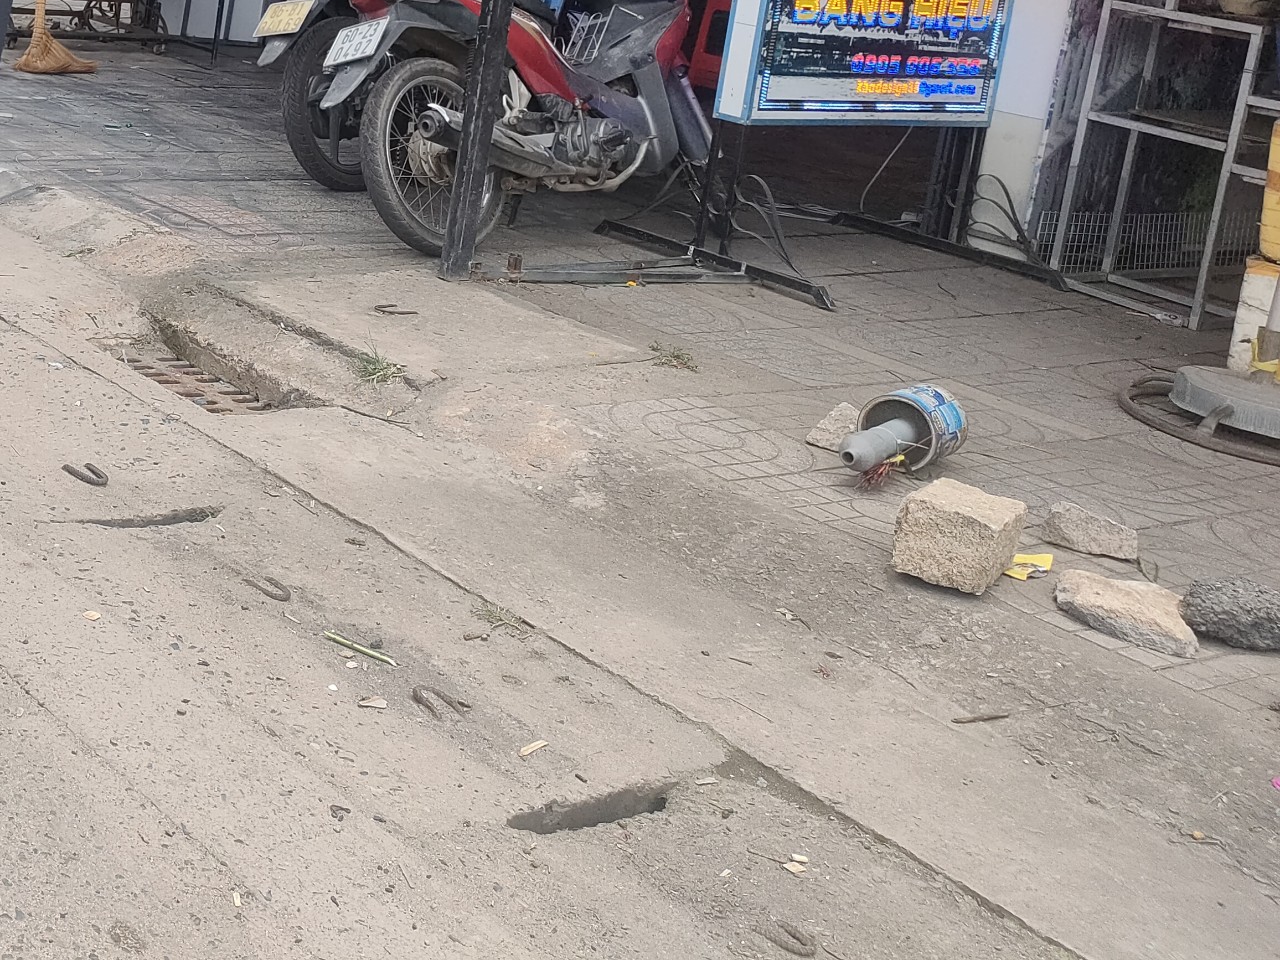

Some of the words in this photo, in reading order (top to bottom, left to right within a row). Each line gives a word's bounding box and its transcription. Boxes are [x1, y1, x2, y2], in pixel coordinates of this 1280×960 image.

[342, 22, 380, 45] 60-Z3
[334, 39, 373, 61] 0492
[851, 53, 902, 75] 0905
